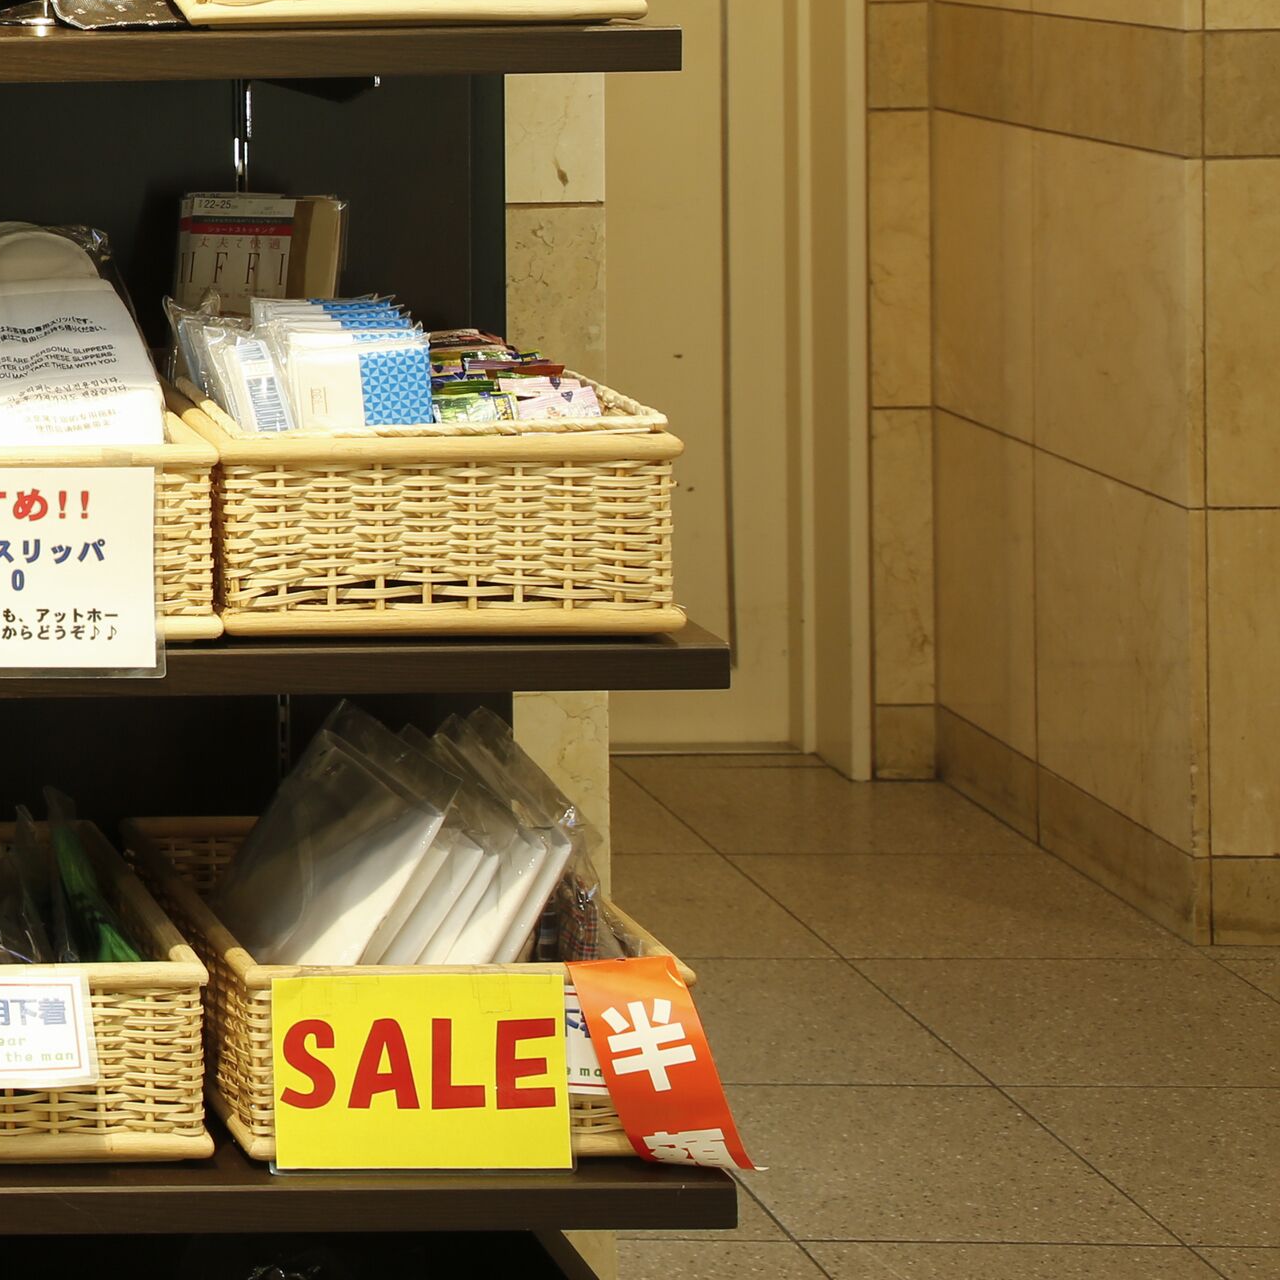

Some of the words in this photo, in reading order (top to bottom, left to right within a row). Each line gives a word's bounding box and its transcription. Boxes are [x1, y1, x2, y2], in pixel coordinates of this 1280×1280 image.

[6, 1051, 33, 1063] the
[41, 1052, 74, 1062] man
[279, 1017, 557, 1110] SALE
